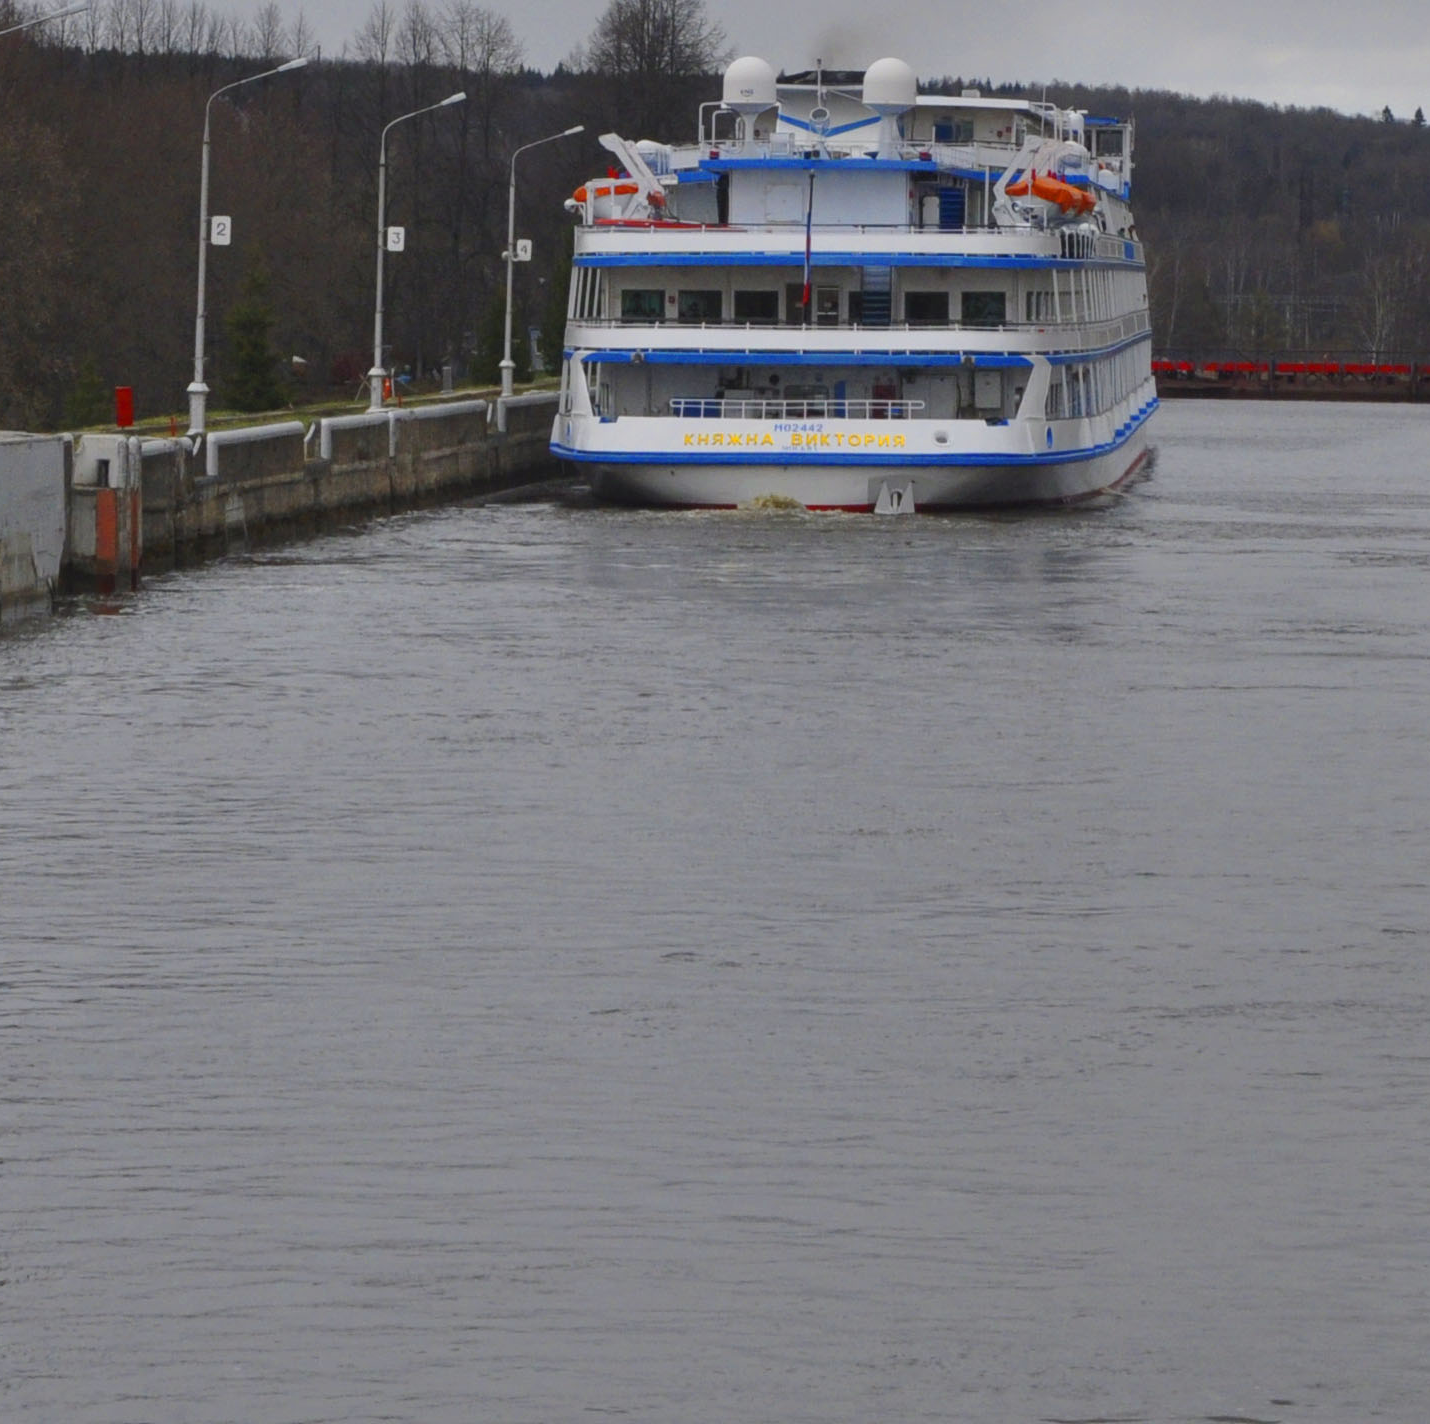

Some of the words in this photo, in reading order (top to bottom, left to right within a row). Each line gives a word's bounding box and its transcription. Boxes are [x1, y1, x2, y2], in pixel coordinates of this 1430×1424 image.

[216, 222, 227, 236] 2
[391, 231, 401, 245] 3
[520, 244, 528, 255] 4
[683, 433, 774, 447] КНЯЖНА
[790, 432, 907, 448] ВИКТОРИЯ
